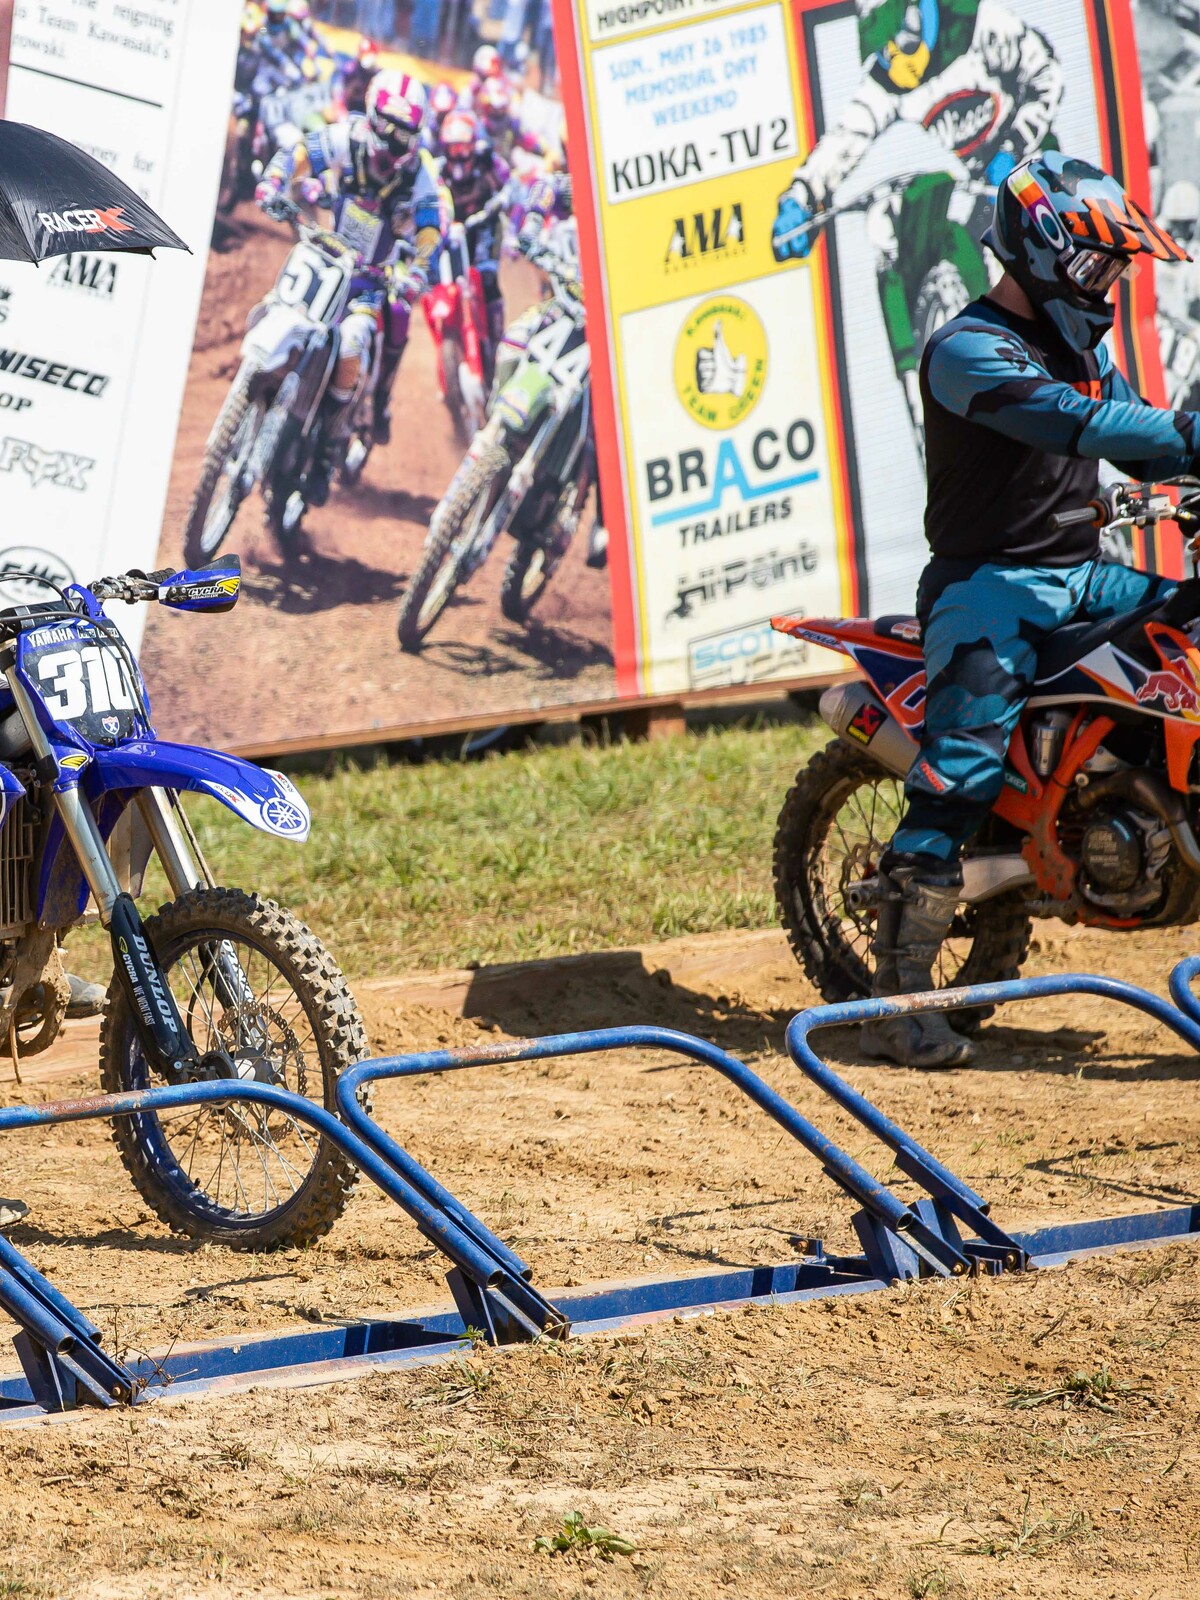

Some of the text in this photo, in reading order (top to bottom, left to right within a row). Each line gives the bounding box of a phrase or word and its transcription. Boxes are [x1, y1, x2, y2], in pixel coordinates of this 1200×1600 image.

[38, 8, 79, 34] Team
[87, 20, 171, 60] Kawasaki's
[113, 3, 175, 37] reigning
[12, 34, 66, 60] rowski.
[659, 44, 695, 68] MAY
[625, 56, 759, 107] MEMORIAL DAY
[652, 90, 739, 128] WEEKEND
[664, 202, 746, 264] AMA
[50, 253, 119, 293] AMA
[278, 243, 345, 323] 51
[646, 418, 816, 504] BRACO
[679, 497, 793, 549] TRAILERS
[189, 585, 225, 598] CYCRA
[27, 626, 75, 648] YAMAHA
[694, 629, 788, 670] SCOT
[37, 645, 137, 722] 310
[122, 953, 139, 984] CYCRA
[142, 1011, 156, 1027] FAST
[132, 933, 179, 1034] DUNLOP
